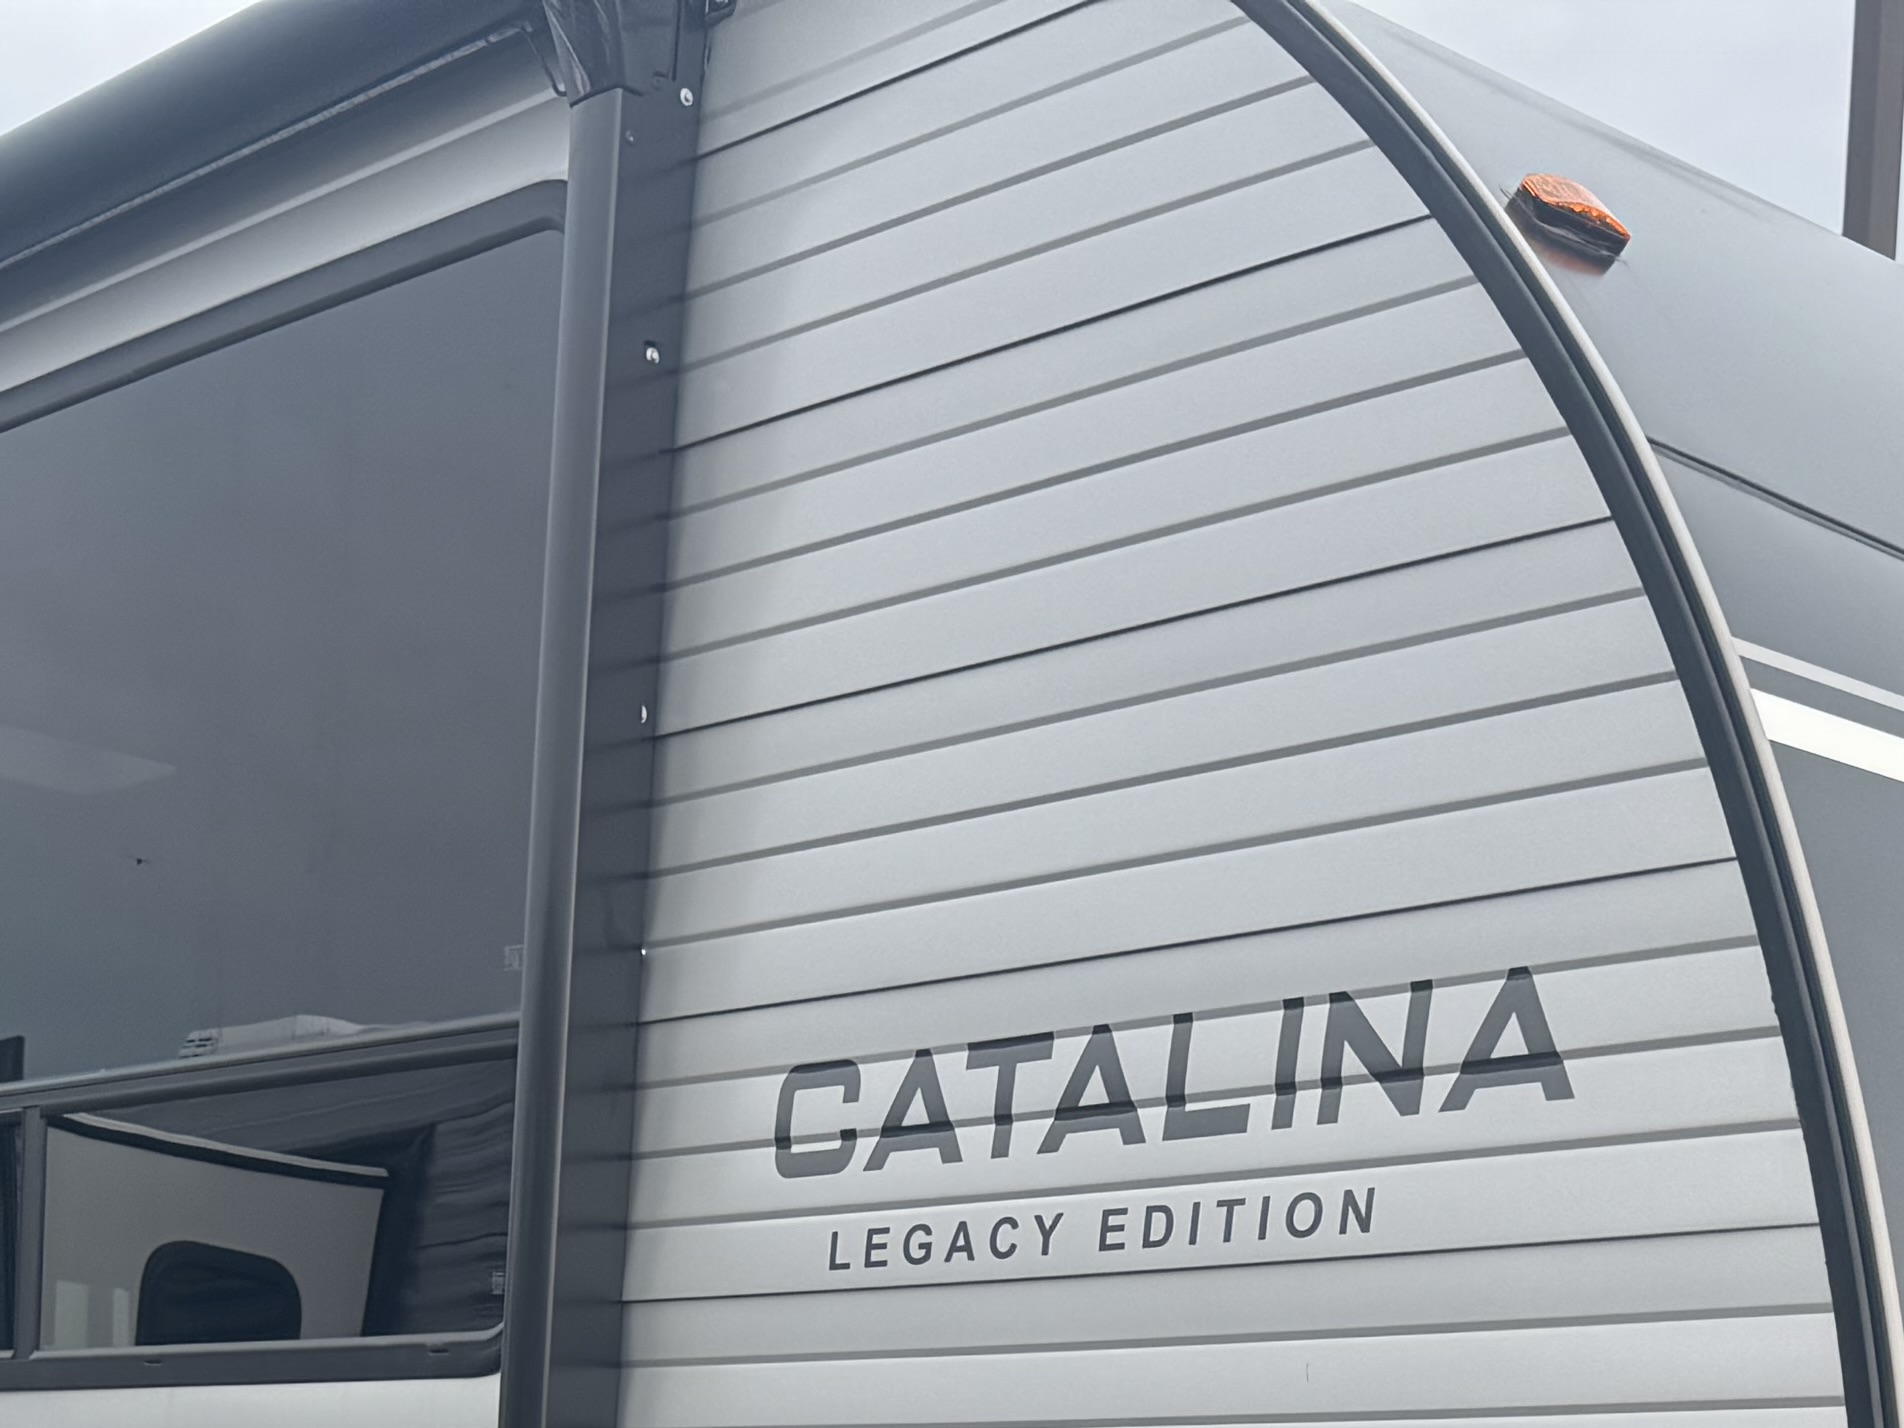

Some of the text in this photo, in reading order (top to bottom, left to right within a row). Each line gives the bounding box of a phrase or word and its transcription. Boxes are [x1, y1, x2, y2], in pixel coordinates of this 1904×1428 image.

[774, 966, 1576, 1180] CATALINA
[828, 1187, 1377, 1271] LEGACY EDITION
